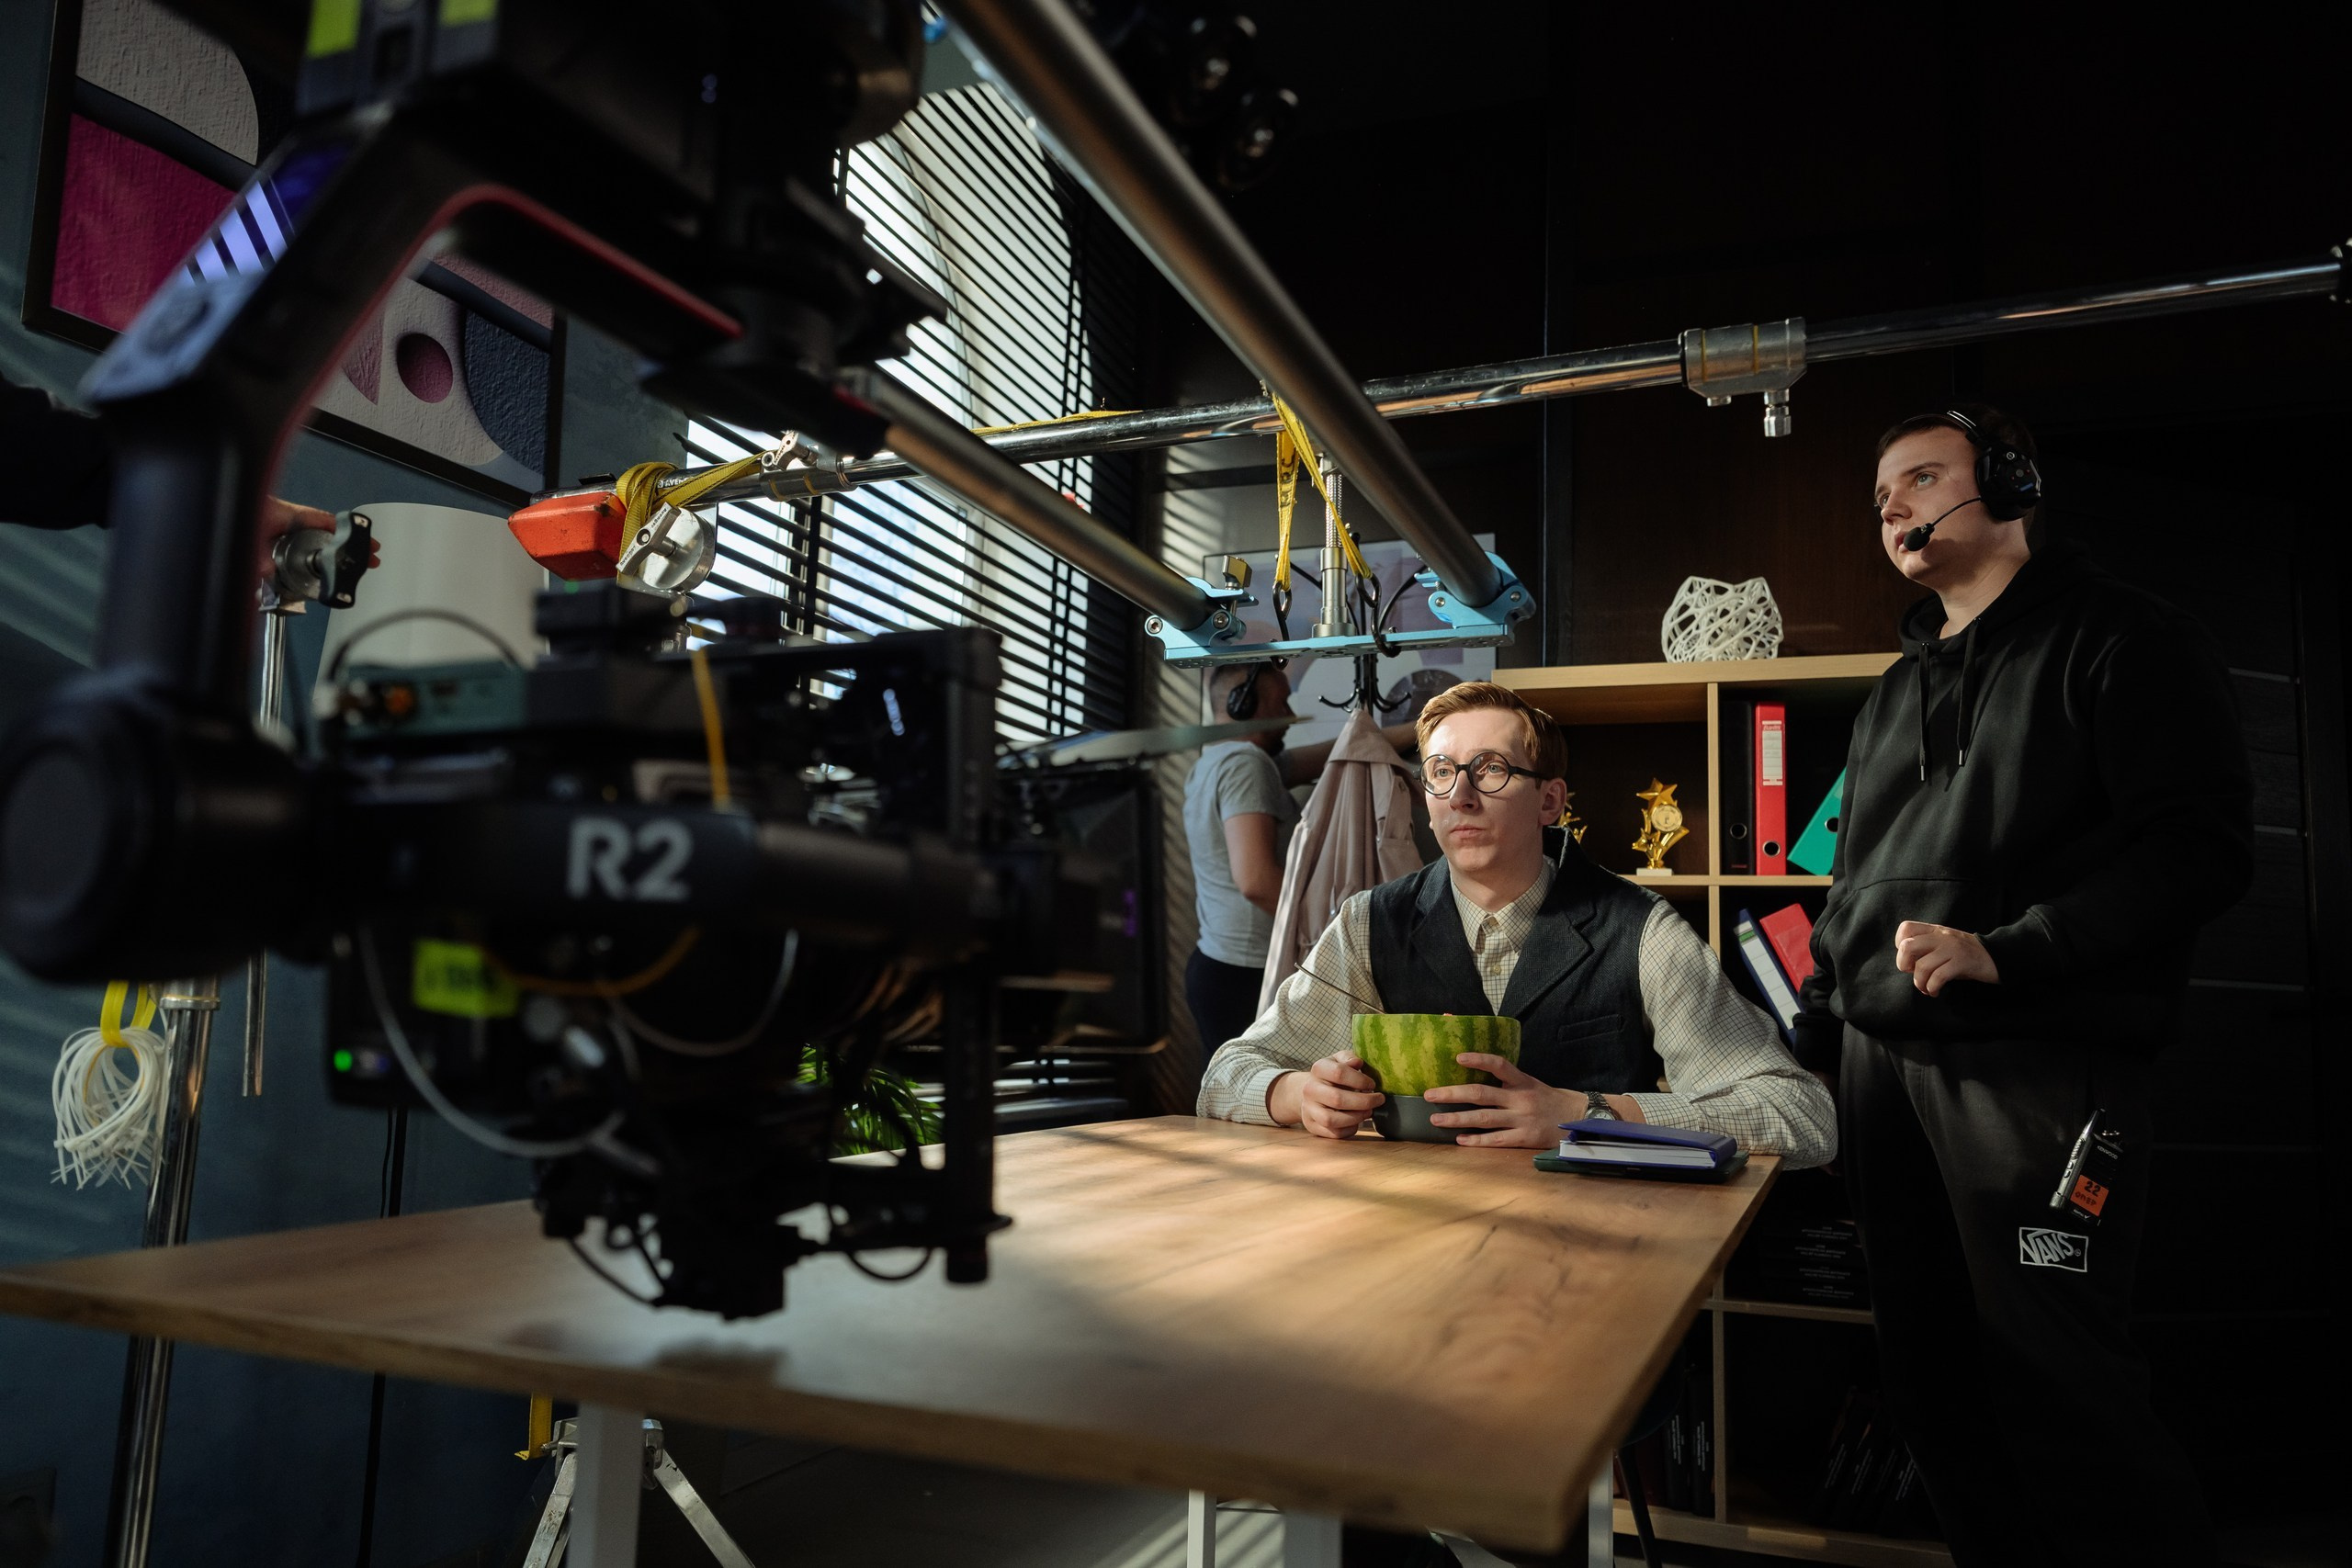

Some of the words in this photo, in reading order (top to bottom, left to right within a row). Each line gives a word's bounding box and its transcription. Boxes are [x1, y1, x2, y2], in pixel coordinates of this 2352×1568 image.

[566, 816, 692, 901] R2
[2084, 1181, 2100, 1197] 22
[2021, 1230, 2074, 1264] VANS
